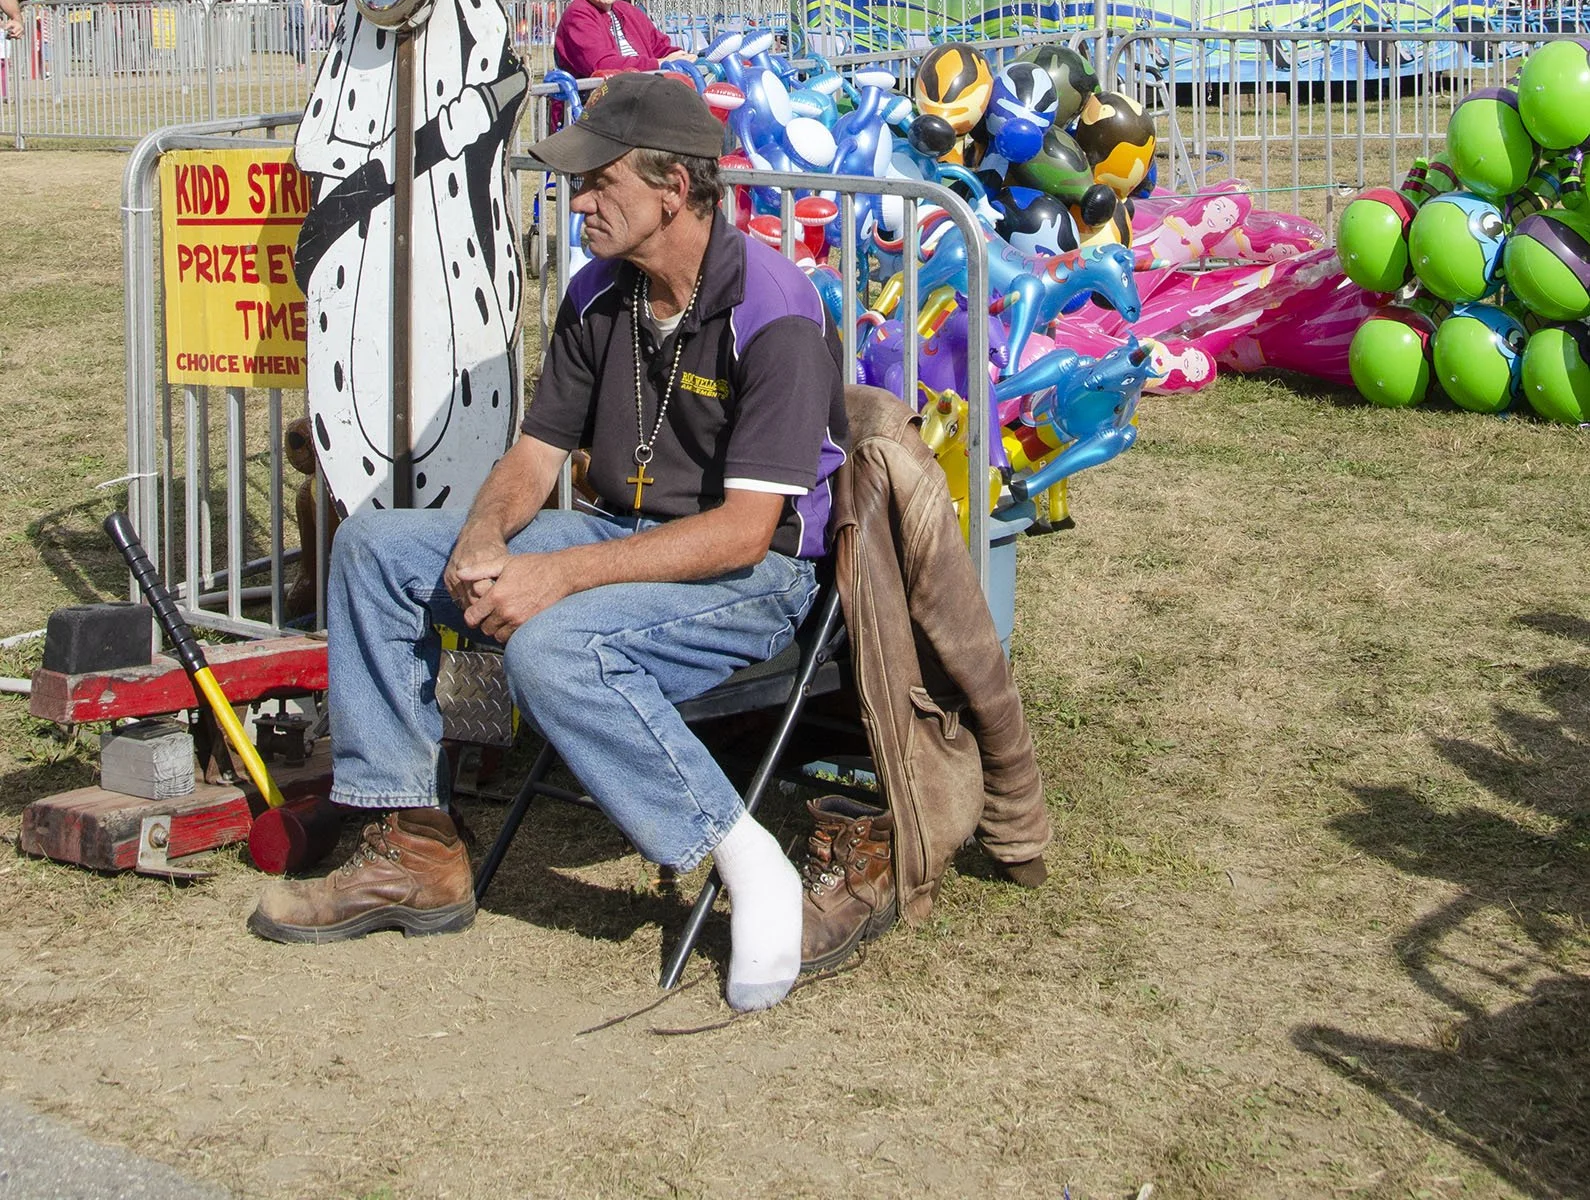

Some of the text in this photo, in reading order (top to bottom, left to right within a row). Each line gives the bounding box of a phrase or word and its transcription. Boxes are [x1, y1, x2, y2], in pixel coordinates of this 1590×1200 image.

[175, 162, 312, 215] KIDD STRI
[176, 244, 260, 284] PRIZE
[235, 300, 307, 341] TIME
[176, 353, 240, 373] CHOICE
[243, 356, 300, 374] WHEN
